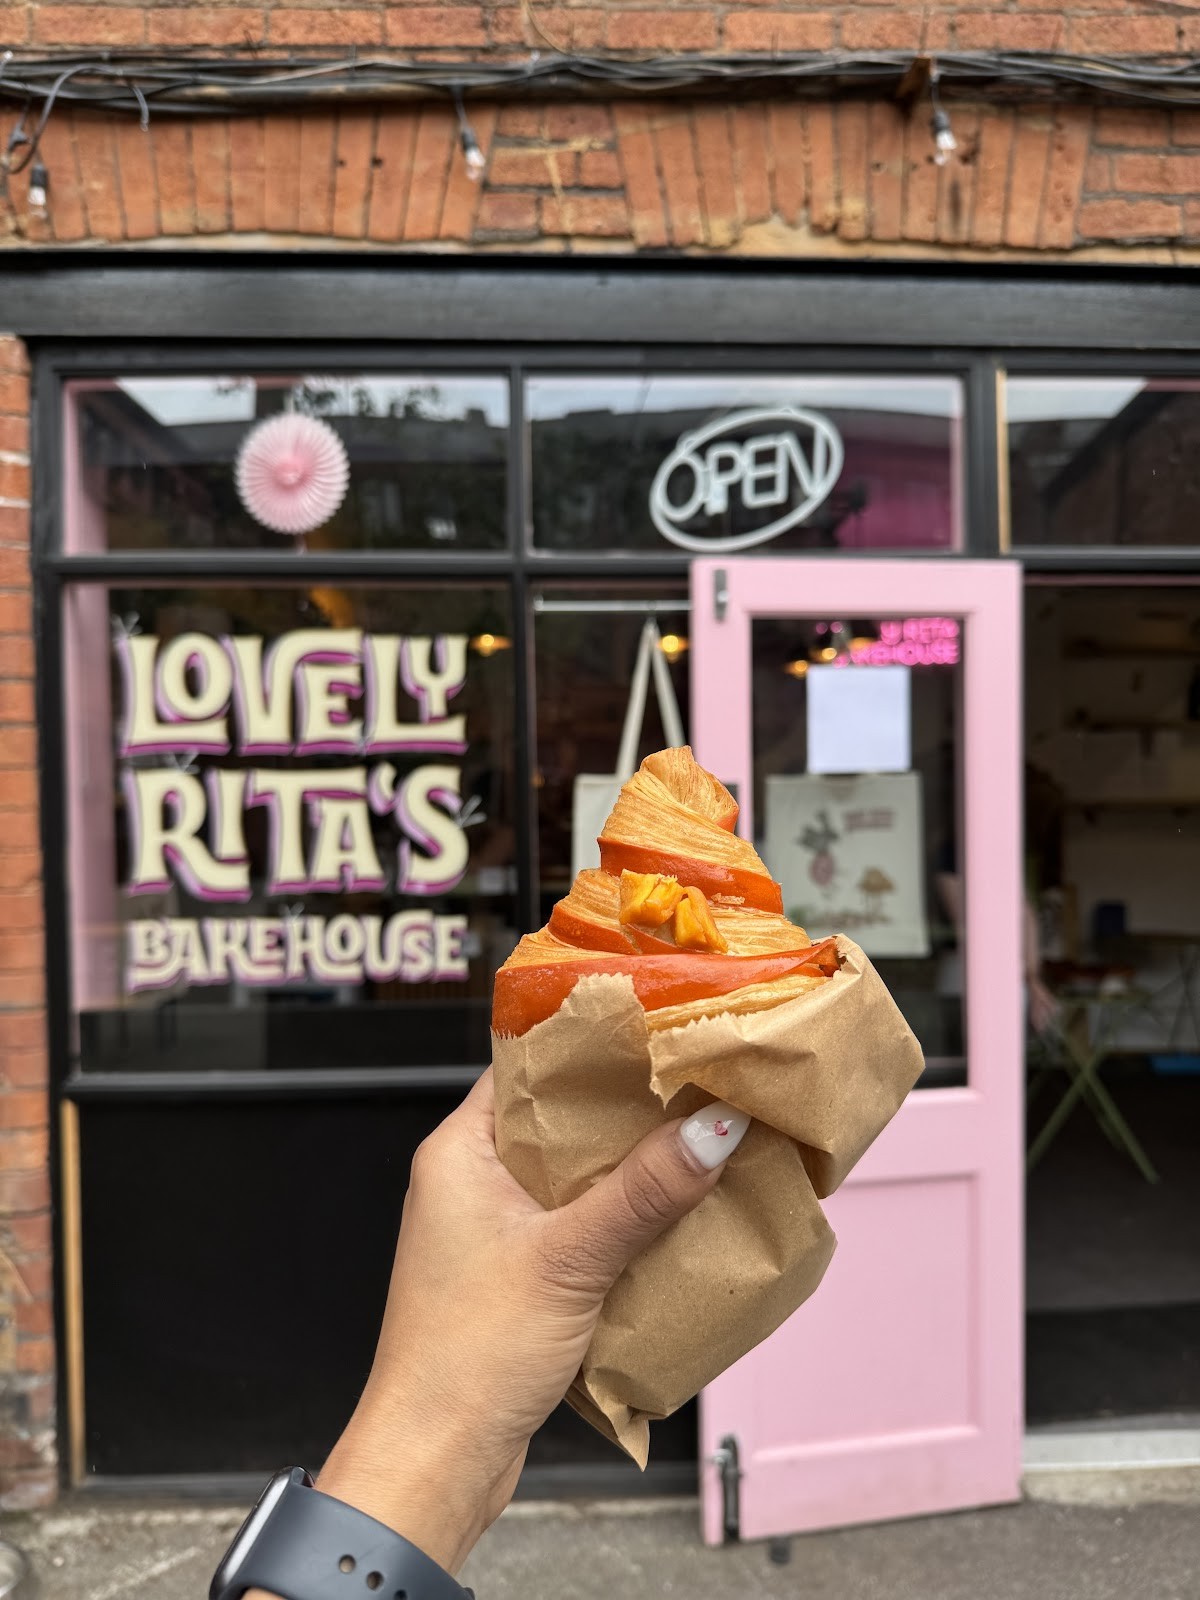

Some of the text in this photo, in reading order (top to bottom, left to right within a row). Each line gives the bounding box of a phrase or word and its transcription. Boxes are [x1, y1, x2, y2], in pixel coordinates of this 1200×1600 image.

[657, 426, 828, 523] OPEN
[118, 628, 470, 757] LOVELY
[122, 761, 471, 901] RITA'S
[127, 909, 470, 994] BAKEHOUSE
